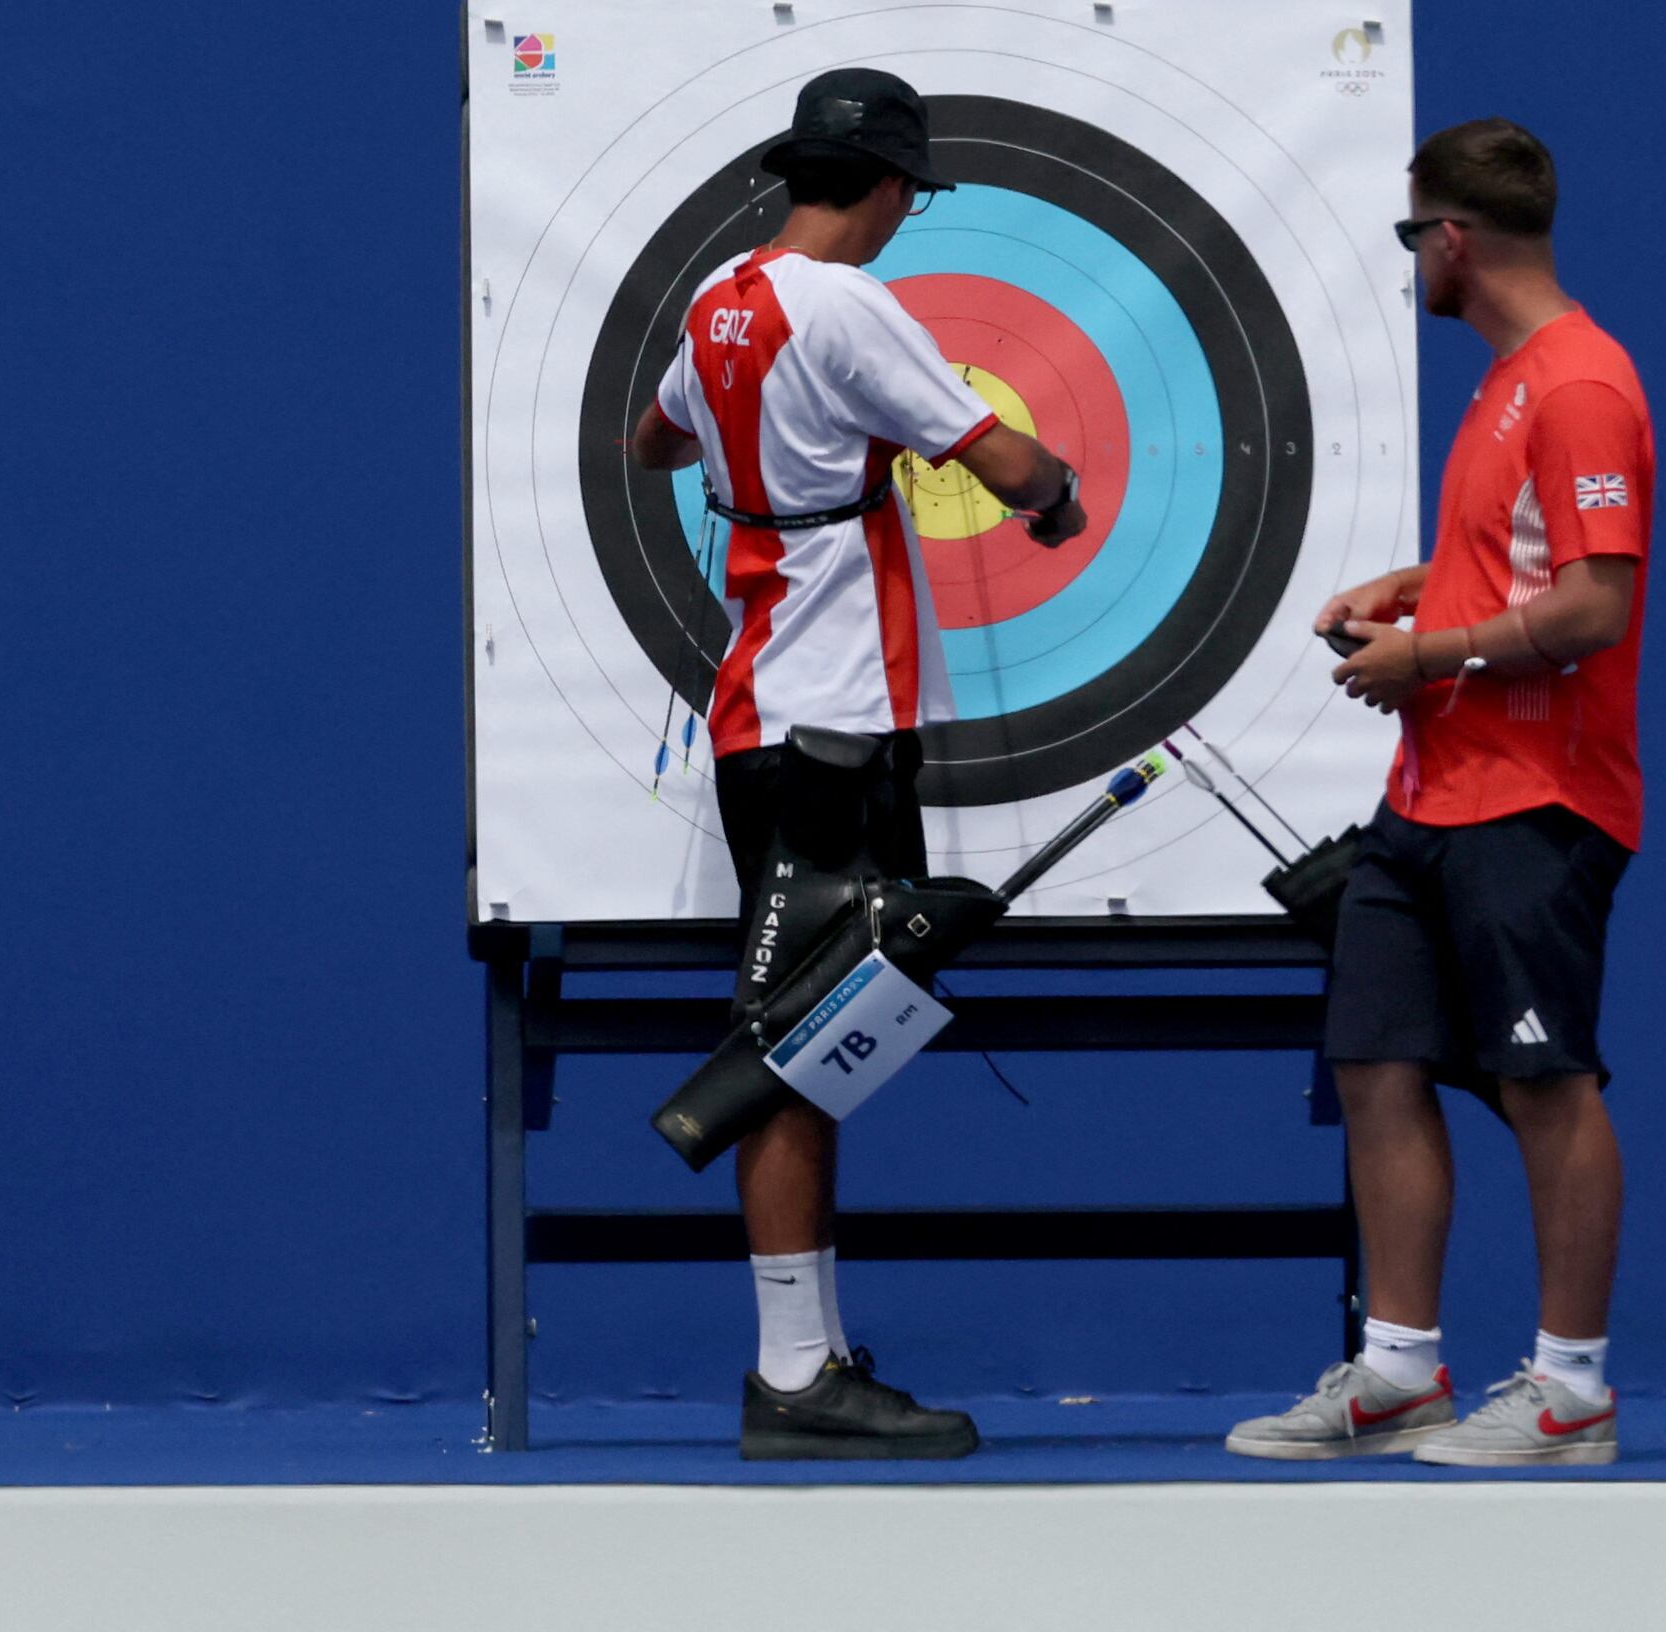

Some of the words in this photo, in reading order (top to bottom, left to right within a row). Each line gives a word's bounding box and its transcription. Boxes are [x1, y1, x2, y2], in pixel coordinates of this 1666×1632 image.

[1285, 441, 1297, 456] 3
[1331, 442, 1342, 456] 2
[776, 862, 795, 879] M
[751, 892, 787, 983] GAZOZ
[809, 1001, 838, 1030] PARIS
[820, 1029, 878, 1075] 7B
